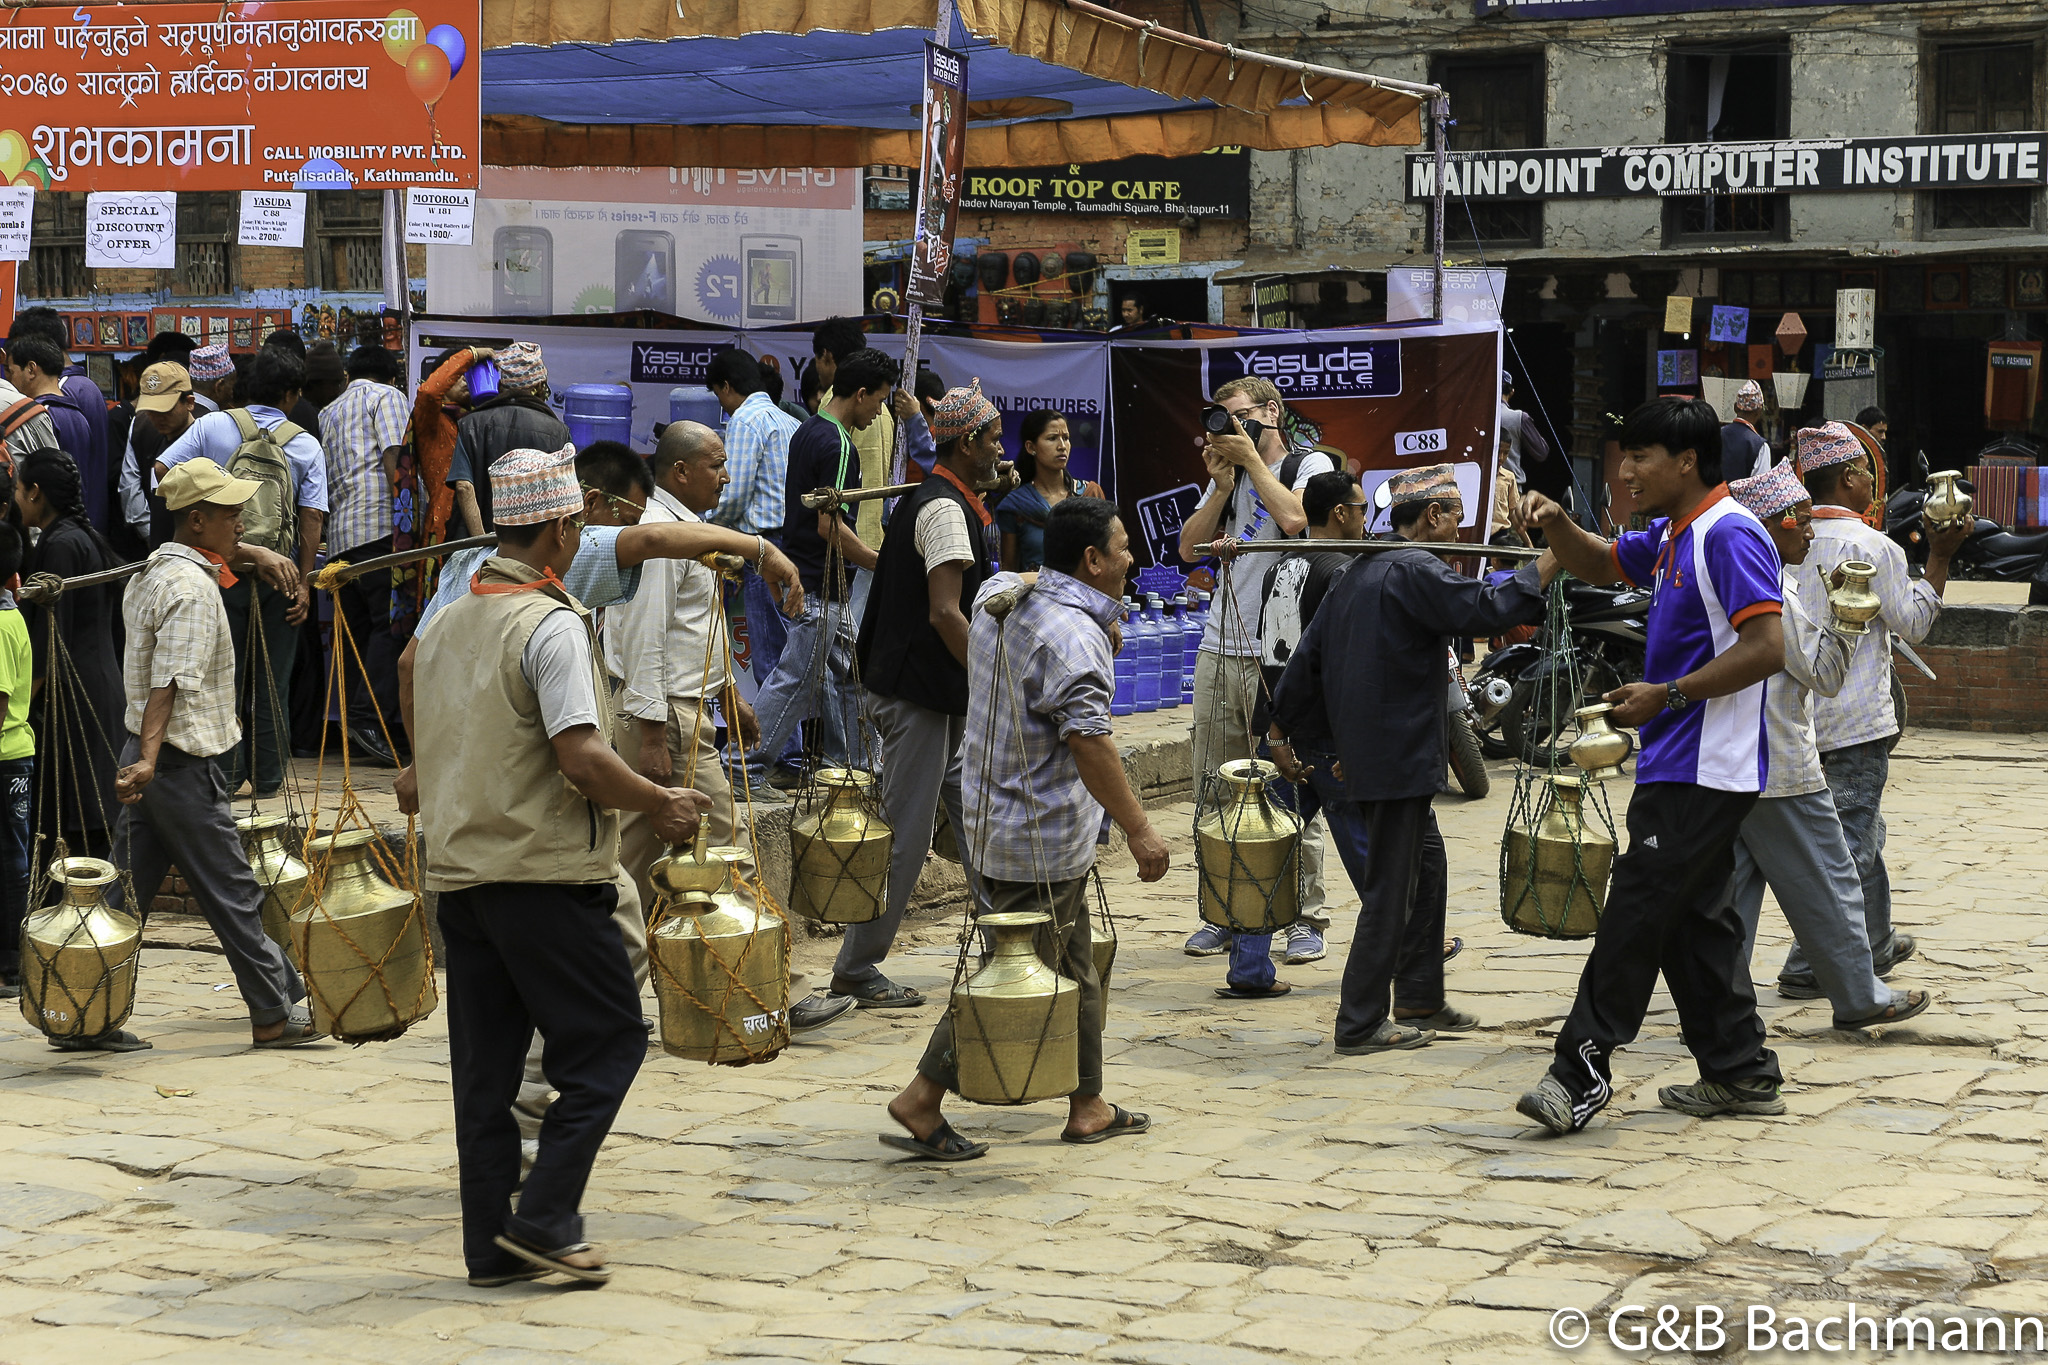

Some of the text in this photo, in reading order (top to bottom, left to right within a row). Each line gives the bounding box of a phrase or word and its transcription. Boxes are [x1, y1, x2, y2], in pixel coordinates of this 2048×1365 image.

[933, 47, 959, 75] Yasuda
[253, 62, 369, 92] मंगलमय
[933, 67, 958, 84] MOBILE
[31, 124, 255, 181] शुभकामना
[263, 145, 467, 159] CALL MOBILITY PVT. LTD.
[263, 168, 459, 184] Putalisadak, Kathmandu.
[1069, 164, 1080, 175] &
[1412, 142, 2039, 197] MAINPOINT COMPUTER INSTITUTE
[970, 177, 1181, 200] ROOF TOP CAFE
[1657, 187, 1700, 197] Taumadhi
[1728, 185, 1777, 195] Bhaktapur
[254, 197, 291, 207] YASUDA
[413, 194, 469, 204] MOTOROLA
[101, 206, 159, 216] SPECIAL
[990, 199, 1029, 210] Narayan
[1032, 200, 1066, 211] Temple
[1075, 201, 1122, 212] Taumadhi
[1124, 203, 1162, 214] Square,
[96, 223, 165, 233] DISCOUNT
[429, 230, 453, 239] 1900/-
[259, 232, 282, 242] 2700/-
[107, 240, 152, 249] OFFER
[1234, 346, 1373, 375] Yasuda
[2006, 356, 2032, 366] PASHMINA
[1260, 372, 1373, 388] OBILE
[1824, 368, 1853, 379] CASHMERE
[992, 395, 1008, 411] IN
[1402, 432, 1439, 451] C88
